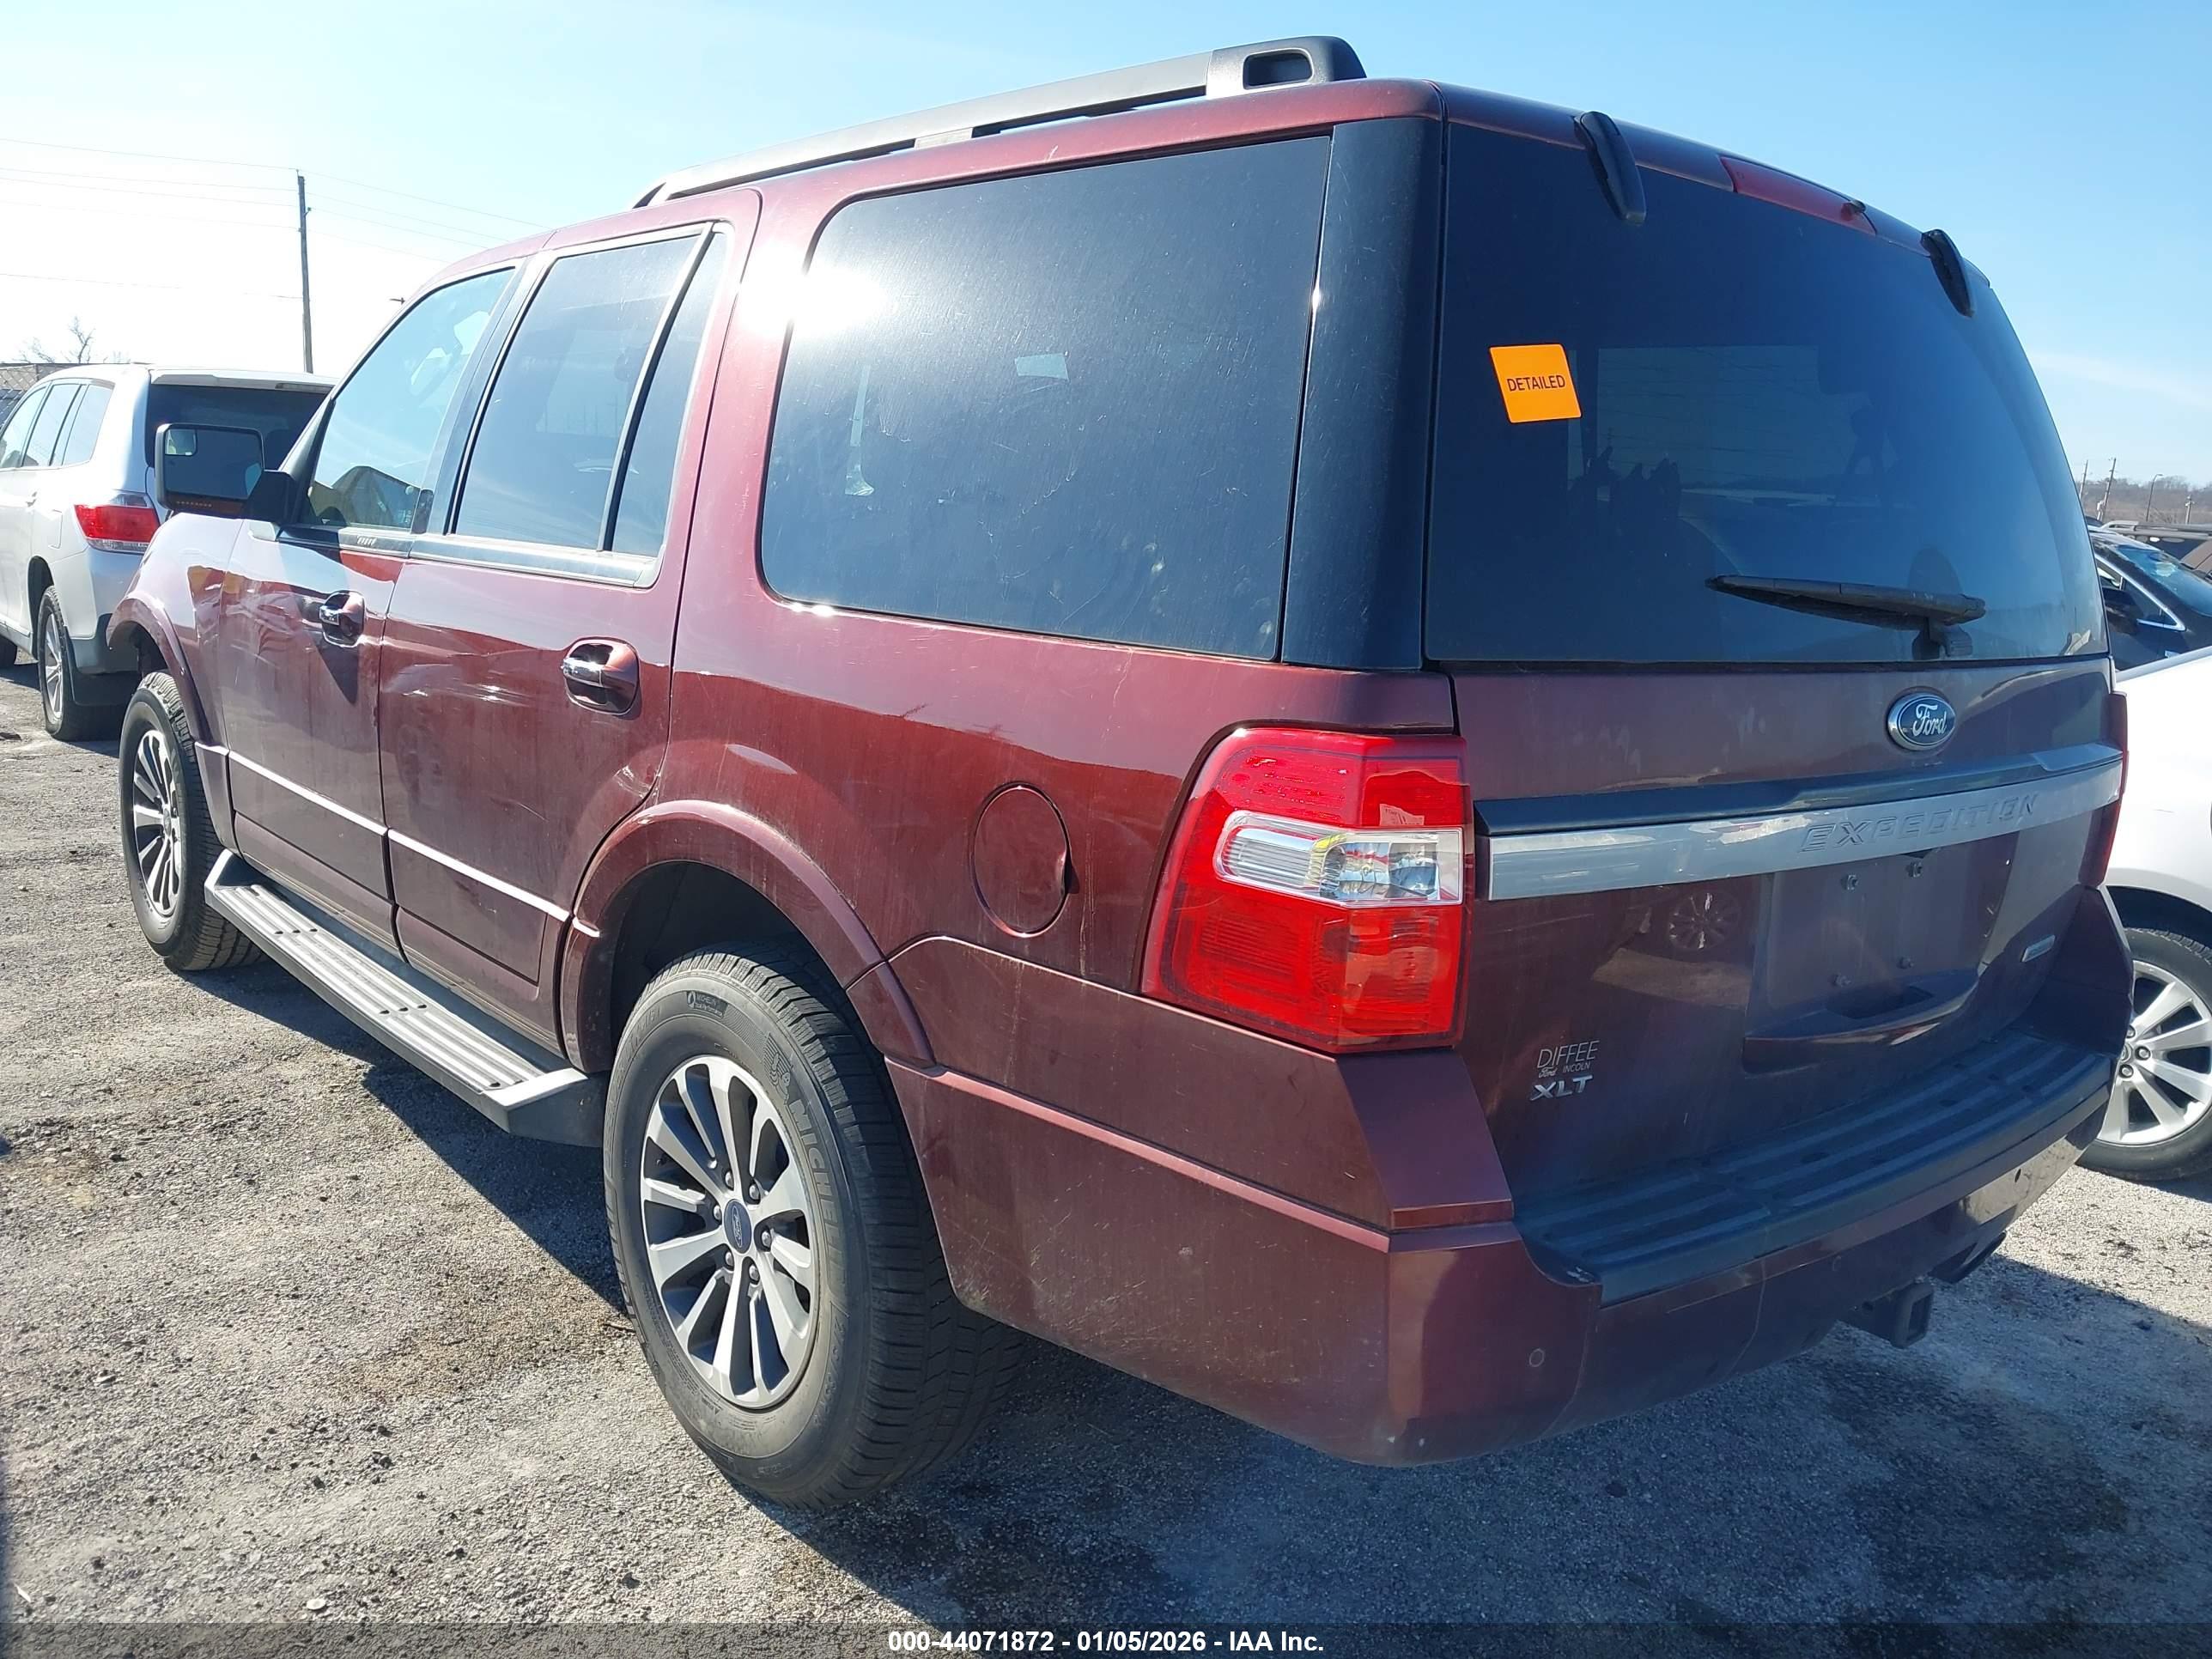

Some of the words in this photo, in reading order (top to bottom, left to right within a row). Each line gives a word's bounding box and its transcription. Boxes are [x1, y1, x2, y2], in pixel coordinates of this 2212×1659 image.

[1506, 374, 1566, 392] DETAILED
[1912, 703, 1948, 737] Ford
[1800, 793, 2039, 853] EXPEDITION
[1536, 1040, 1601, 1069] DIFFEE
[1529, 1074, 1594, 1101] XLT
[788, 1098, 847, 1286] MICHELIN
